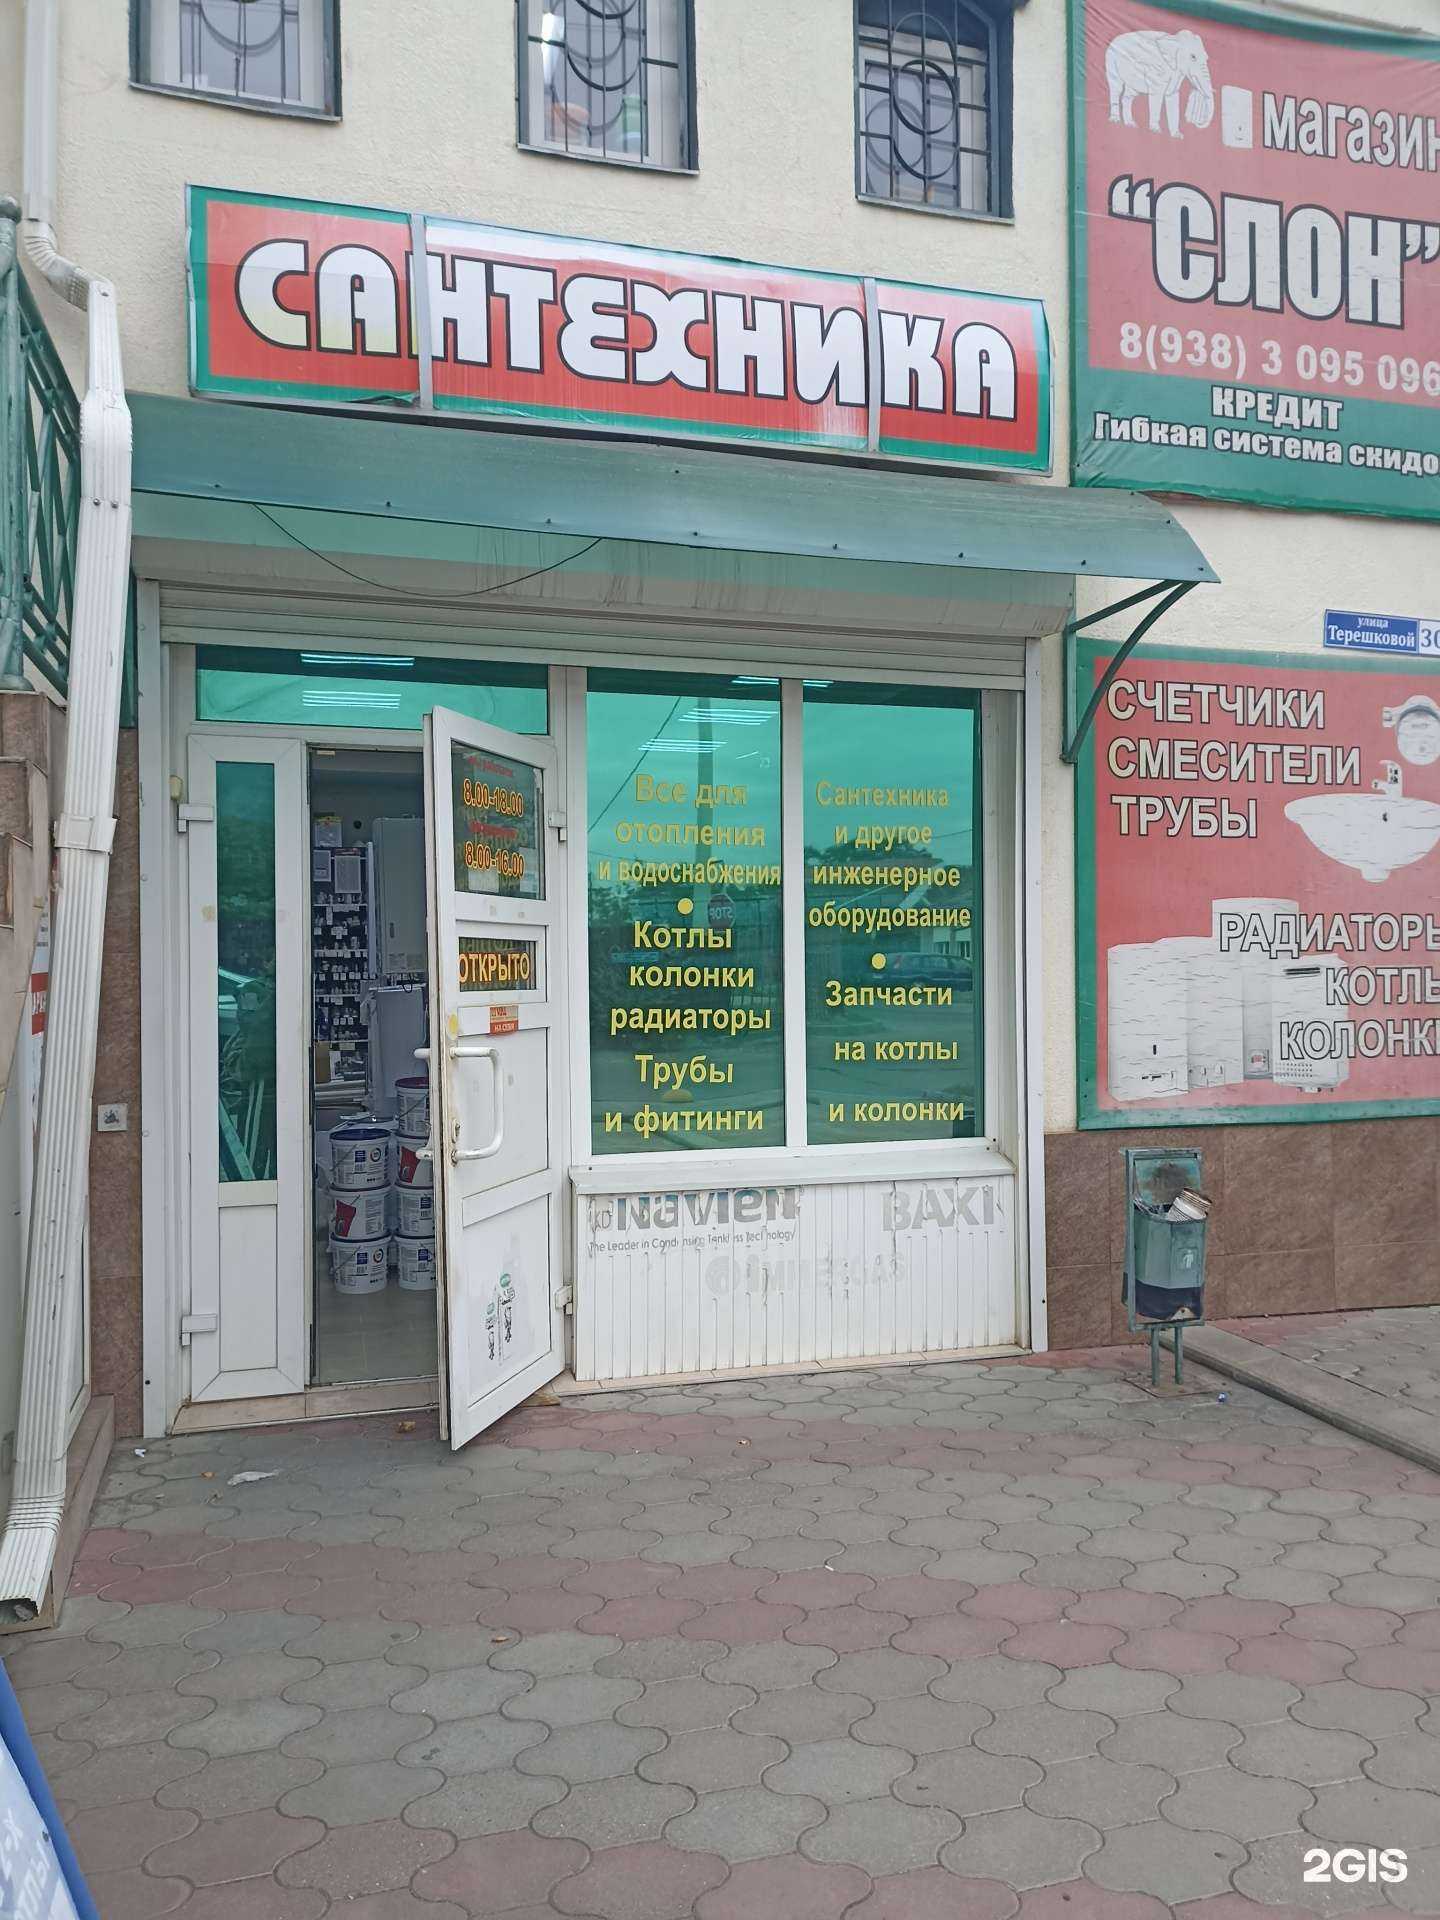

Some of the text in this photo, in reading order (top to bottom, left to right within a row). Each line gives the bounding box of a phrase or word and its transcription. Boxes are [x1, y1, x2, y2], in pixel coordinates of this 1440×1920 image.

[234, 237, 1018, 423] САНТЕХНИКА
[1119, 321, 1440, 396] 8(938) 3 095 096
[1211, 385, 1343, 431] КРЕДИТ
[1093, 411, 1440, 478] Гибкая система скидо
[1328, 625, 1415, 647] Терешковой
[1357, 617, 1389, 629] улица
[1106, 678, 1326, 730] СЧЕТЧИКИ
[1106, 736, 1361, 786] СМЕСИТЕЛИ
[463, 778, 523, 817] 8.00-18.00
[634, 774, 748, 808] Все для
[815, 780, 949, 808] Сантехника
[1111, 794, 1258, 838] ТРУБЫ
[616, 821, 766, 848] отопления
[834, 825, 933, 852] и другое
[464, 840, 525, 880] 8.00-16.00
[598, 858, 781, 887] и водоснабжения
[812, 864, 962, 892] инженерное
[808, 901, 972, 934] оборудование
[633, 920, 732, 949] Котлы
[458, 953, 530, 983] ОТКРЫТО
[629, 965, 755, 988] колонки
[825, 980, 953, 1007] Запчасти
[611, 1006, 771, 1036] радиаторы
[834, 1038, 959, 1061] на котлы
[1280, 1018, 1440, 1060] КОЛОНК
[634, 1053, 734, 1090] Трубы
[605, 1103, 764, 1139] и фитинги
[828, 1100, 965, 1122] и колонки
[882, 1186, 994, 1231] BAXI
[608, 1240, 639, 1252] Leader
[652, 1236, 705, 1251] Condnsing
[708, 1232, 744, 1244] Tanklss
